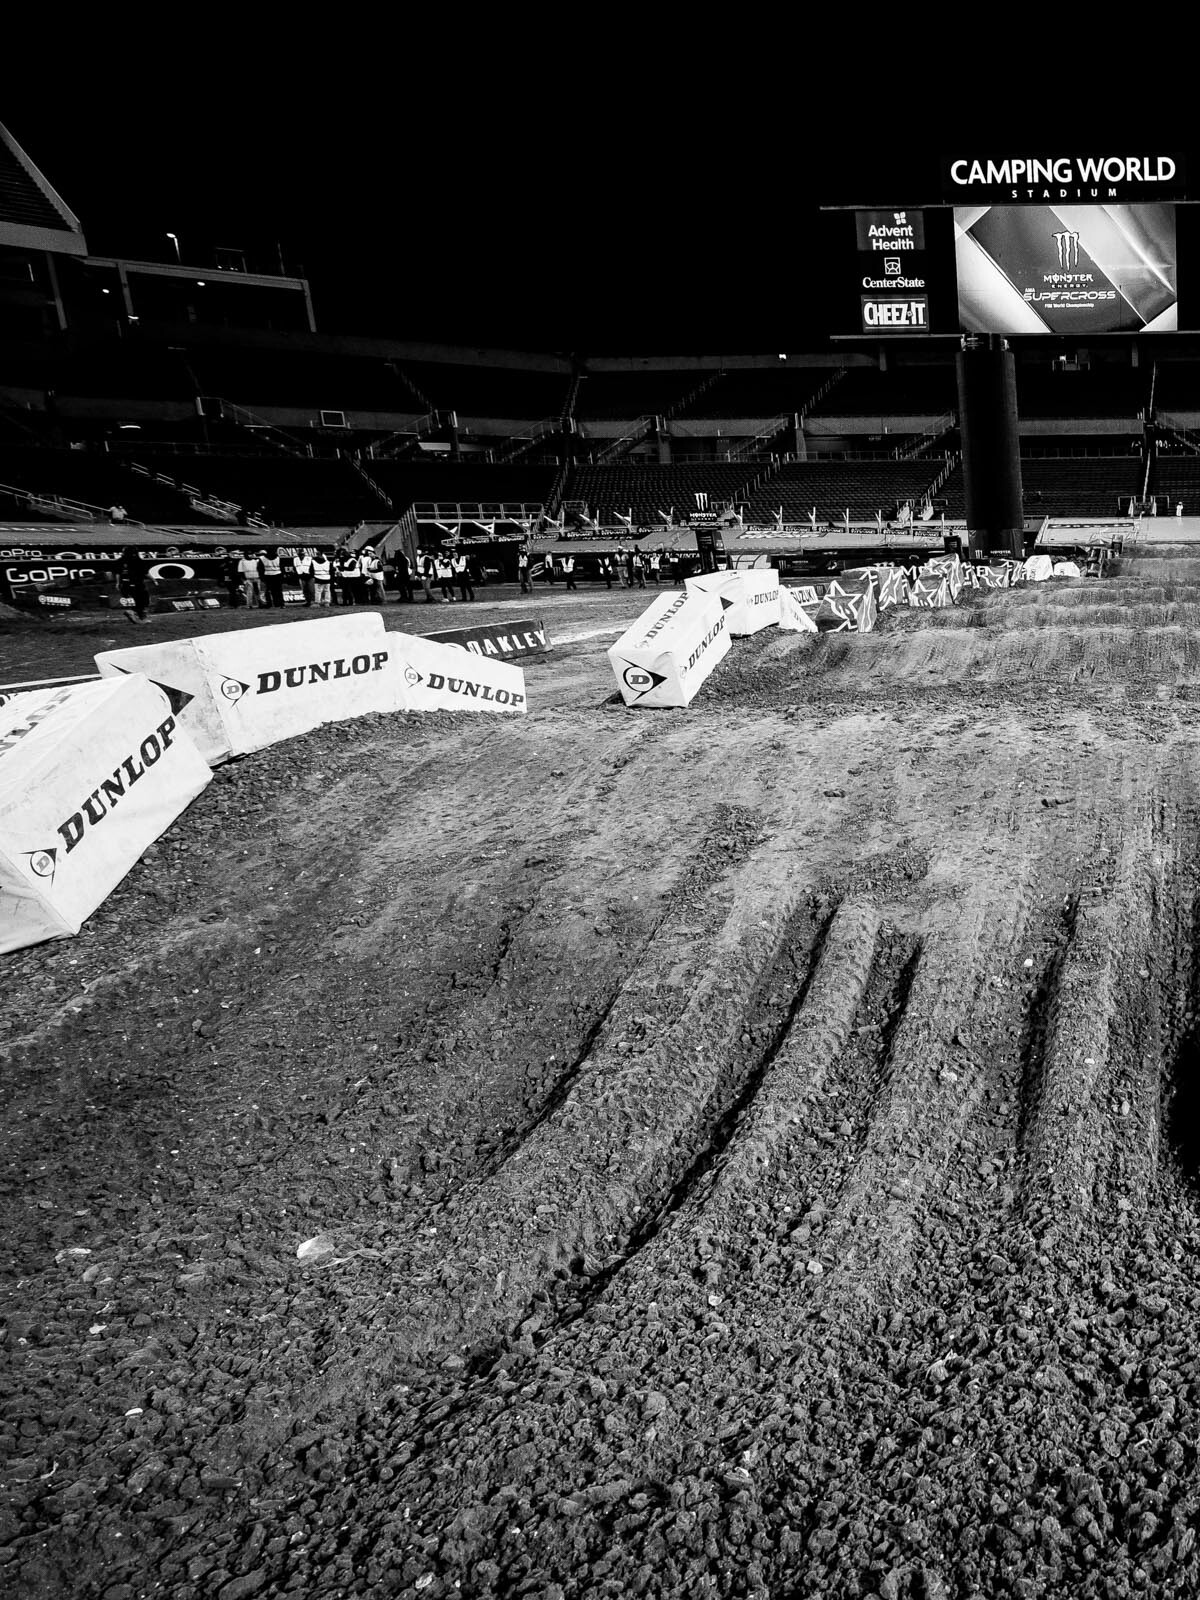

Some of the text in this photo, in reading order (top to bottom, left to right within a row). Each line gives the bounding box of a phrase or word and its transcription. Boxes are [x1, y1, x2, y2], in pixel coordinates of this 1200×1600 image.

[950, 157, 1176, 185] CAMPING WORLD
[1012, 188, 1117, 198] STADIUM
[868, 225, 913, 236] Advent
[872, 238, 914, 250] Health
[862, 277, 925, 288] CenterState
[1043, 273, 1093, 283] MONSTER
[1023, 291, 1116, 301] SUPERCROSS
[1, 548, 42, 557] oPro
[6, 567, 96, 582] GoPro
[647, 592, 689, 640] DUNLOP
[467, 630, 546, 656] OAKLEY
[688, 615, 725, 670] DUNLOP
[256, 651, 389, 695] DUNLOP
[426, 672, 524, 707] DUNLOP
[57, 715, 176, 854] DUNLOP
